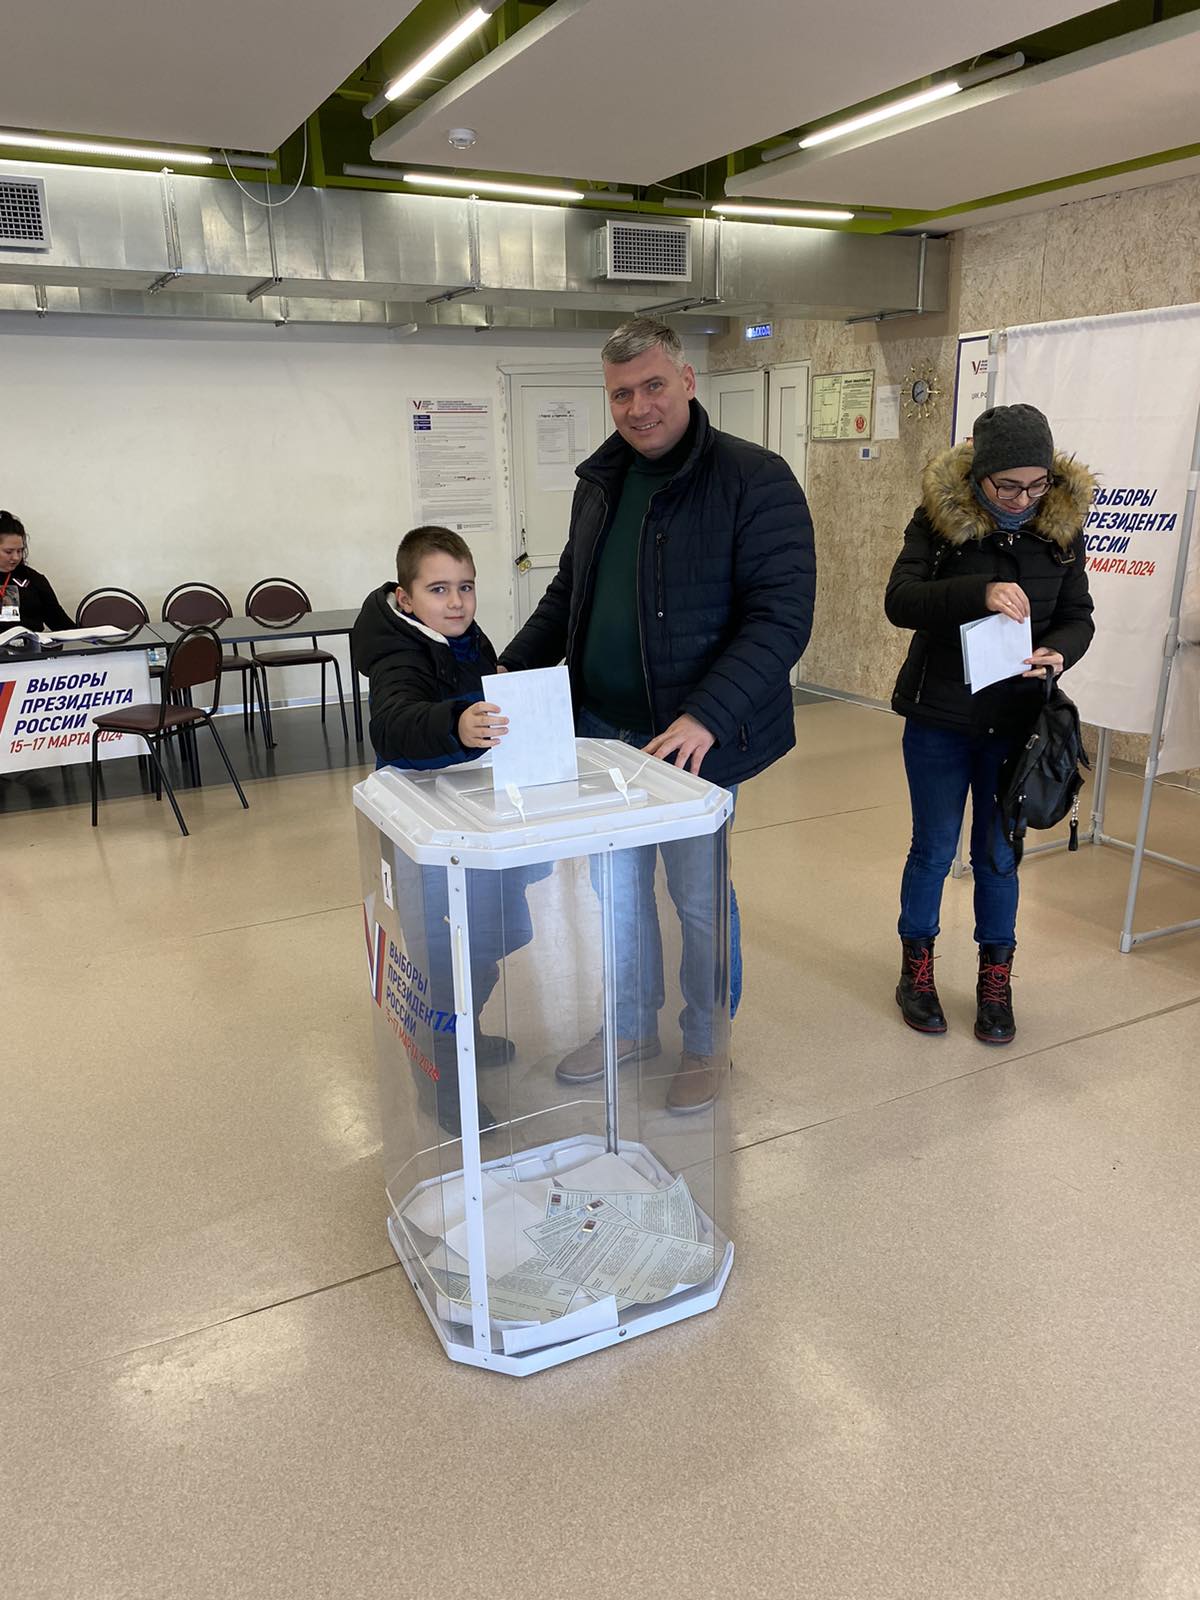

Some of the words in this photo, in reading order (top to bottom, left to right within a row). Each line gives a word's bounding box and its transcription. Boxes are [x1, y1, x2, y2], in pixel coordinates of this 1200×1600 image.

[746, 325, 770, 338] ЫХОД
[1089, 557, 1127, 575] МАРТА
[1127, 560, 1156, 577] 2024
[26, 671, 108, 694] ВЫБОРЫ
[20, 688, 134, 714] ПРЕЗИДЕНТА
[13, 713, 88, 736] РОССИИ
[47, 731, 92, 749] МАРТА
[389, 940, 428, 995] ВЫБОРЫ
[387, 963, 458, 1034] ПРЕЗИДЕНТА
[386, 985, 417, 1038] РОССИИ
